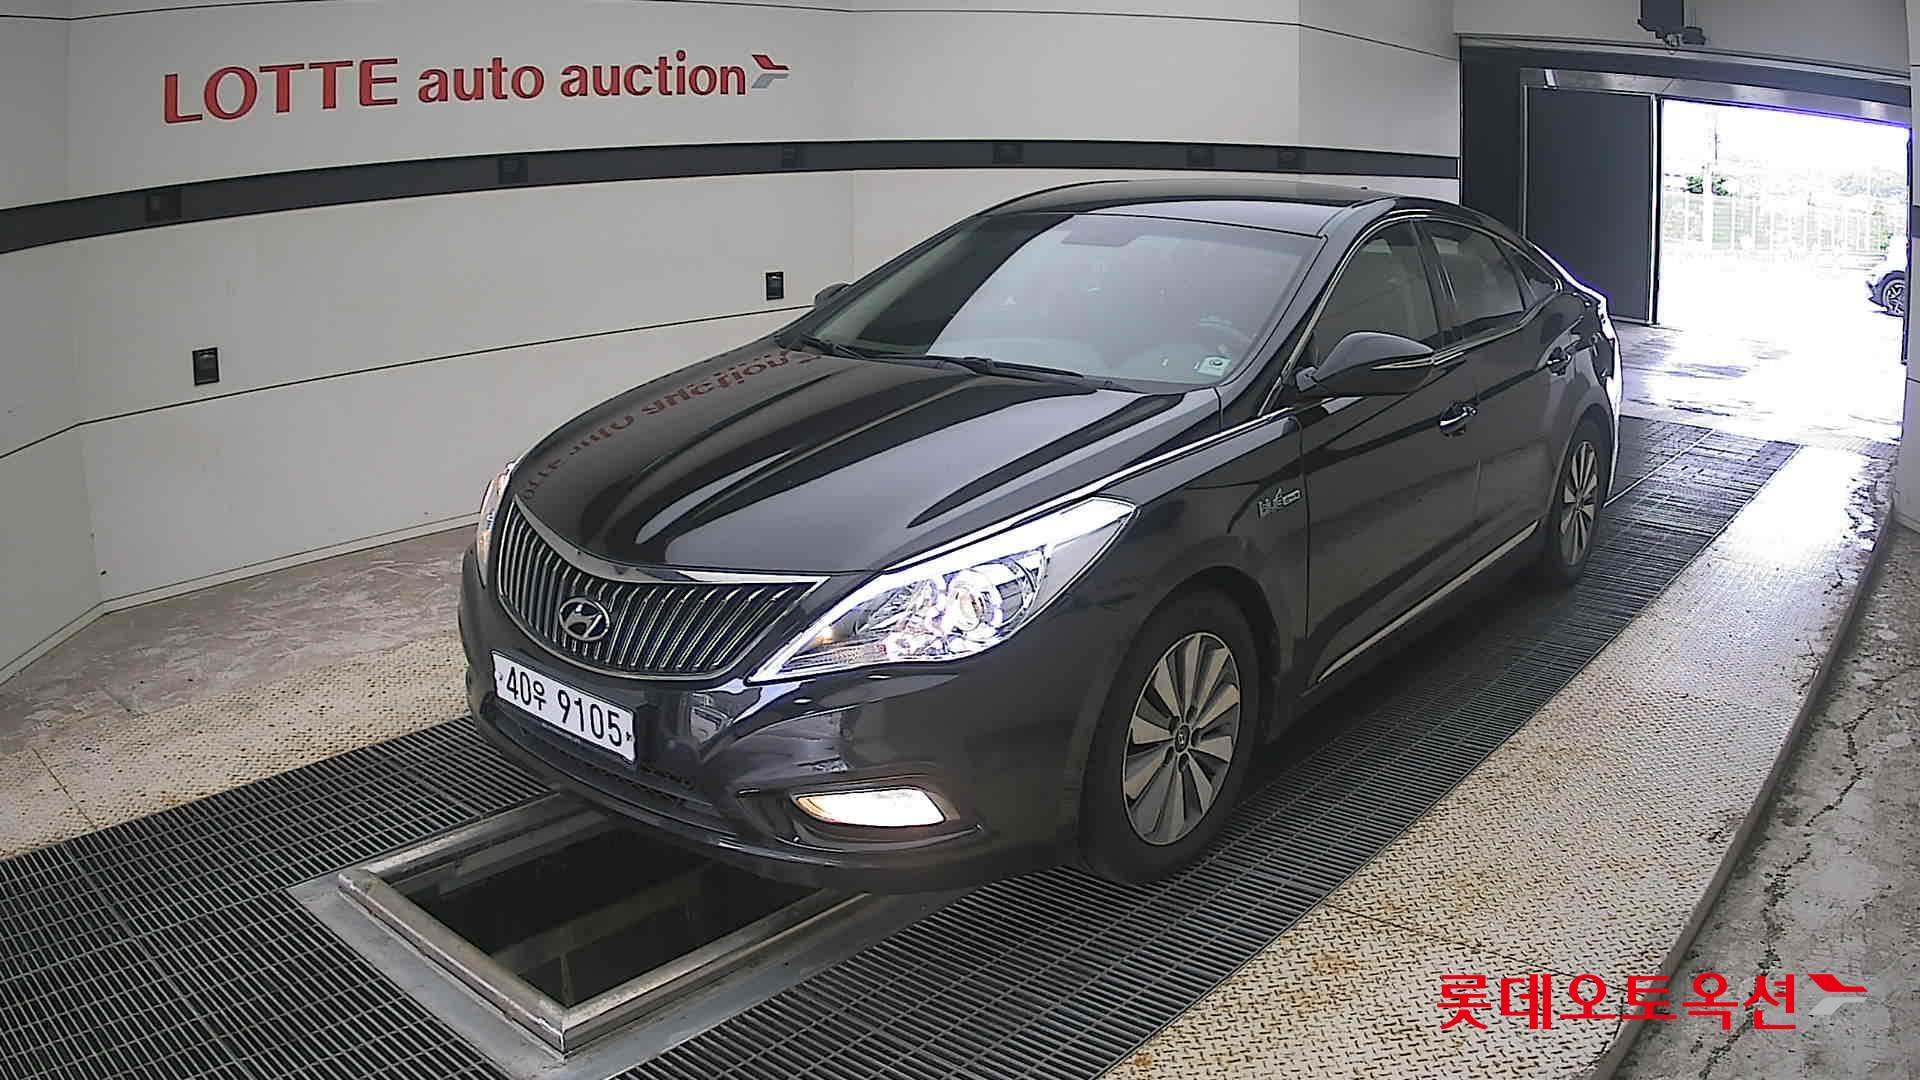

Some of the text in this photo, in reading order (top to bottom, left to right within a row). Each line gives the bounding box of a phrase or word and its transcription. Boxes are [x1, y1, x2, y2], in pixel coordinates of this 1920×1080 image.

[163, 50, 747, 124] LOTTE auto auction
[506, 666, 622, 747] 40우 9105
